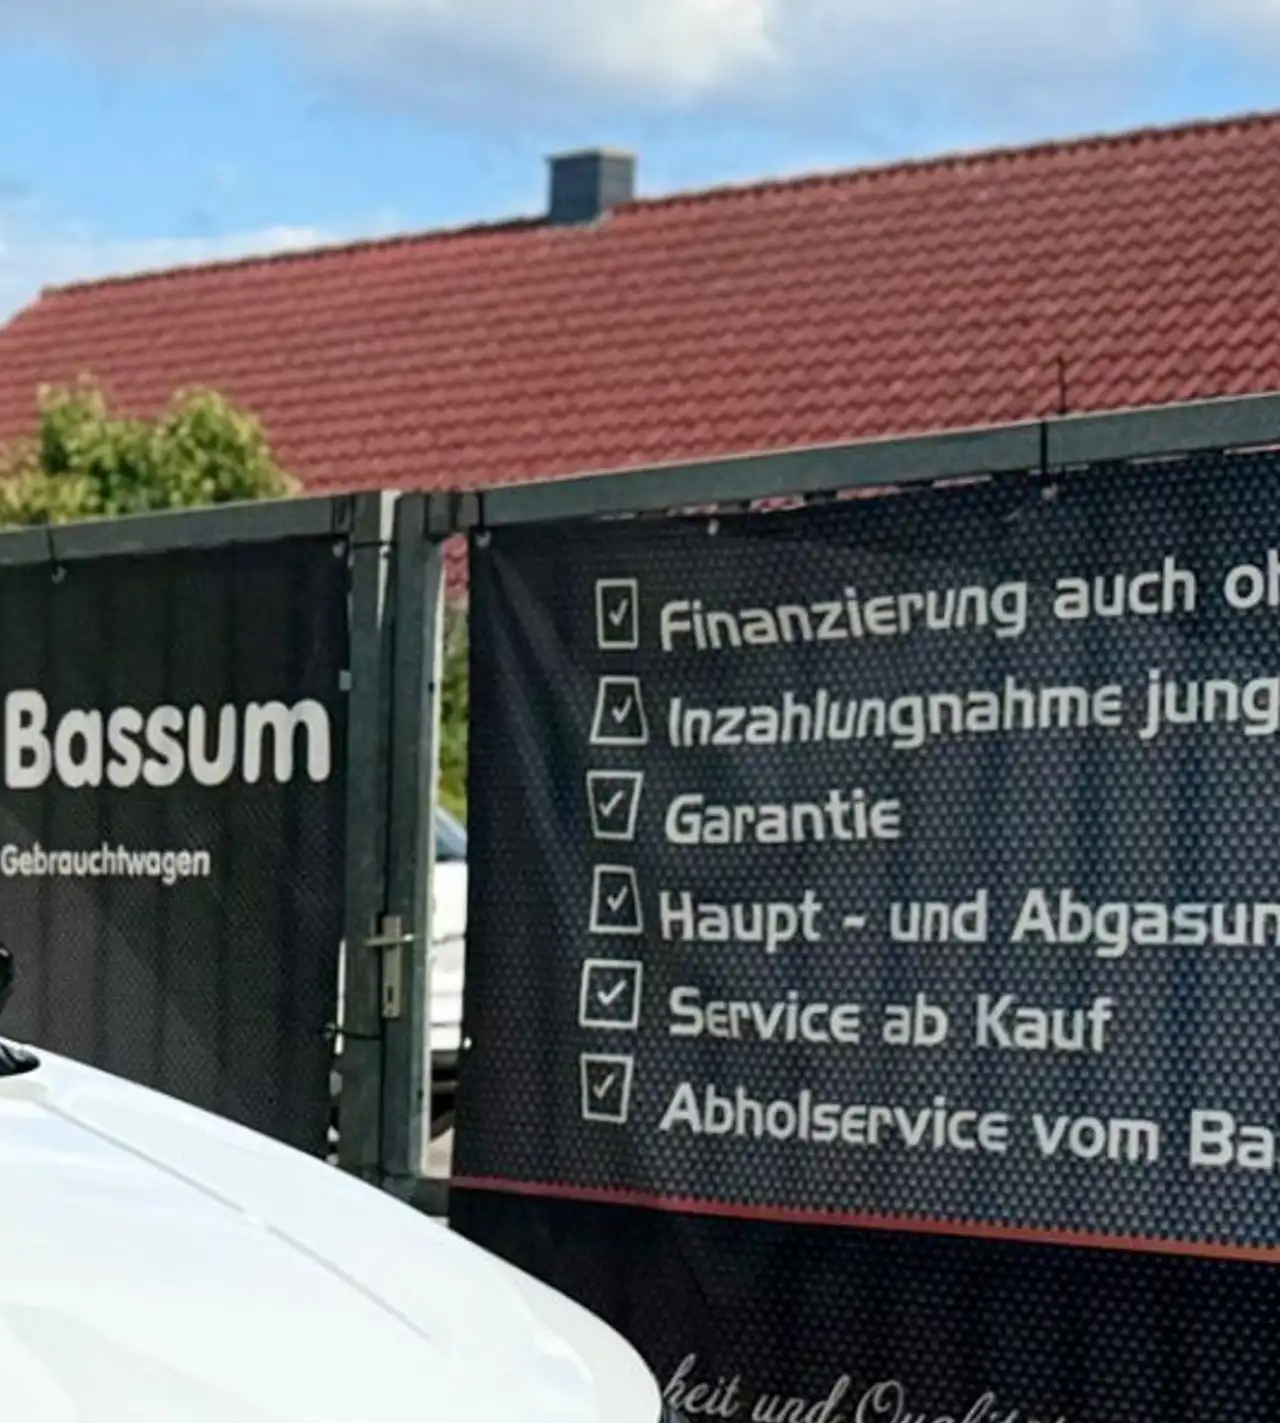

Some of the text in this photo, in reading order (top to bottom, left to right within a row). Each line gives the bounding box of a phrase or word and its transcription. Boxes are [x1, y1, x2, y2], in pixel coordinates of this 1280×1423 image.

[660, 580, 1028, 651] Finanzierung
[1053, 556, 1196, 620] auch
[6, 689, 331, 789] Bassum
[668, 668, 1280, 748] Inzahlungnahme jung
[664, 788, 902, 845] Garantie
[0, 844, 211, 885] Gebrauchtwagen
[660, 890, 822, 953] Haupt
[890, 889, 988, 942] und
[1010, 888, 1280, 957] Abgasun
[668, 986, 1113, 1051] Service ab Kauf
[659, 1083, 1009, 1152] Abholservice
[1032, 1113, 1159, 1163] vom
